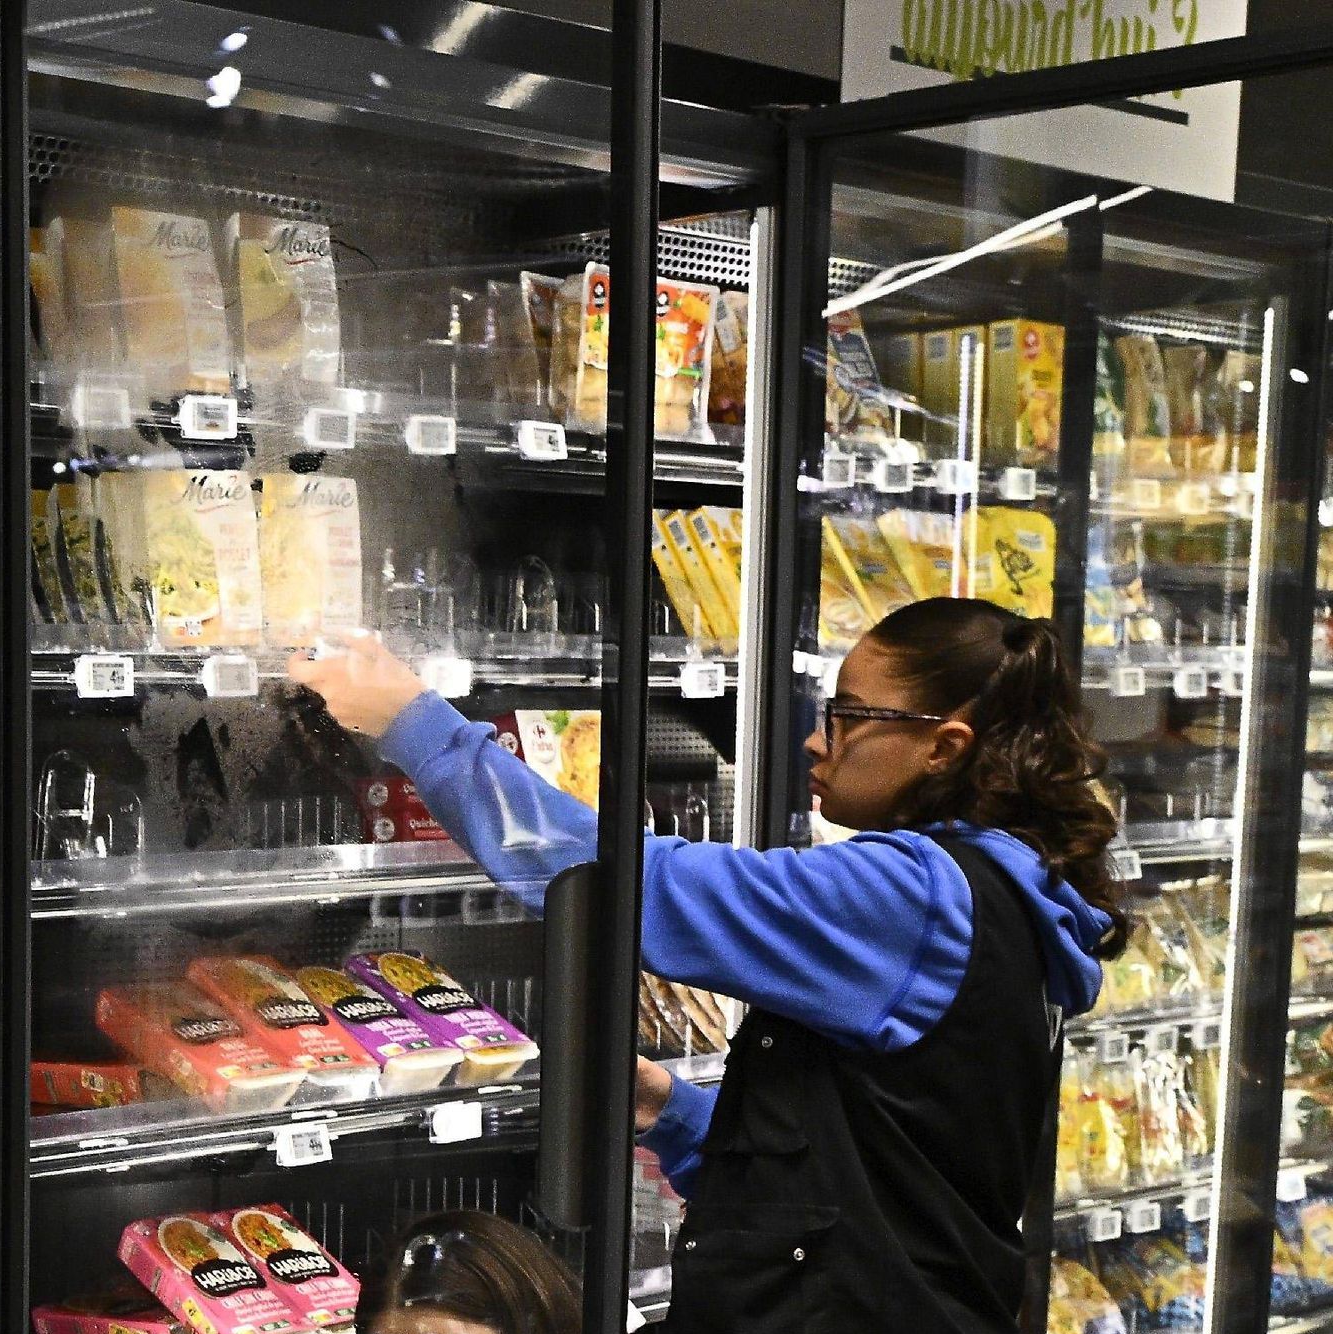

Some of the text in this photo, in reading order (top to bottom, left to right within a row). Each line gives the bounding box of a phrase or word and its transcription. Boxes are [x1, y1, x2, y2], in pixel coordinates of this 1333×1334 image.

[264, 226, 331, 257] Marie
[179, 475, 248, 505] Marie
[286, 480, 355, 509] Marie
